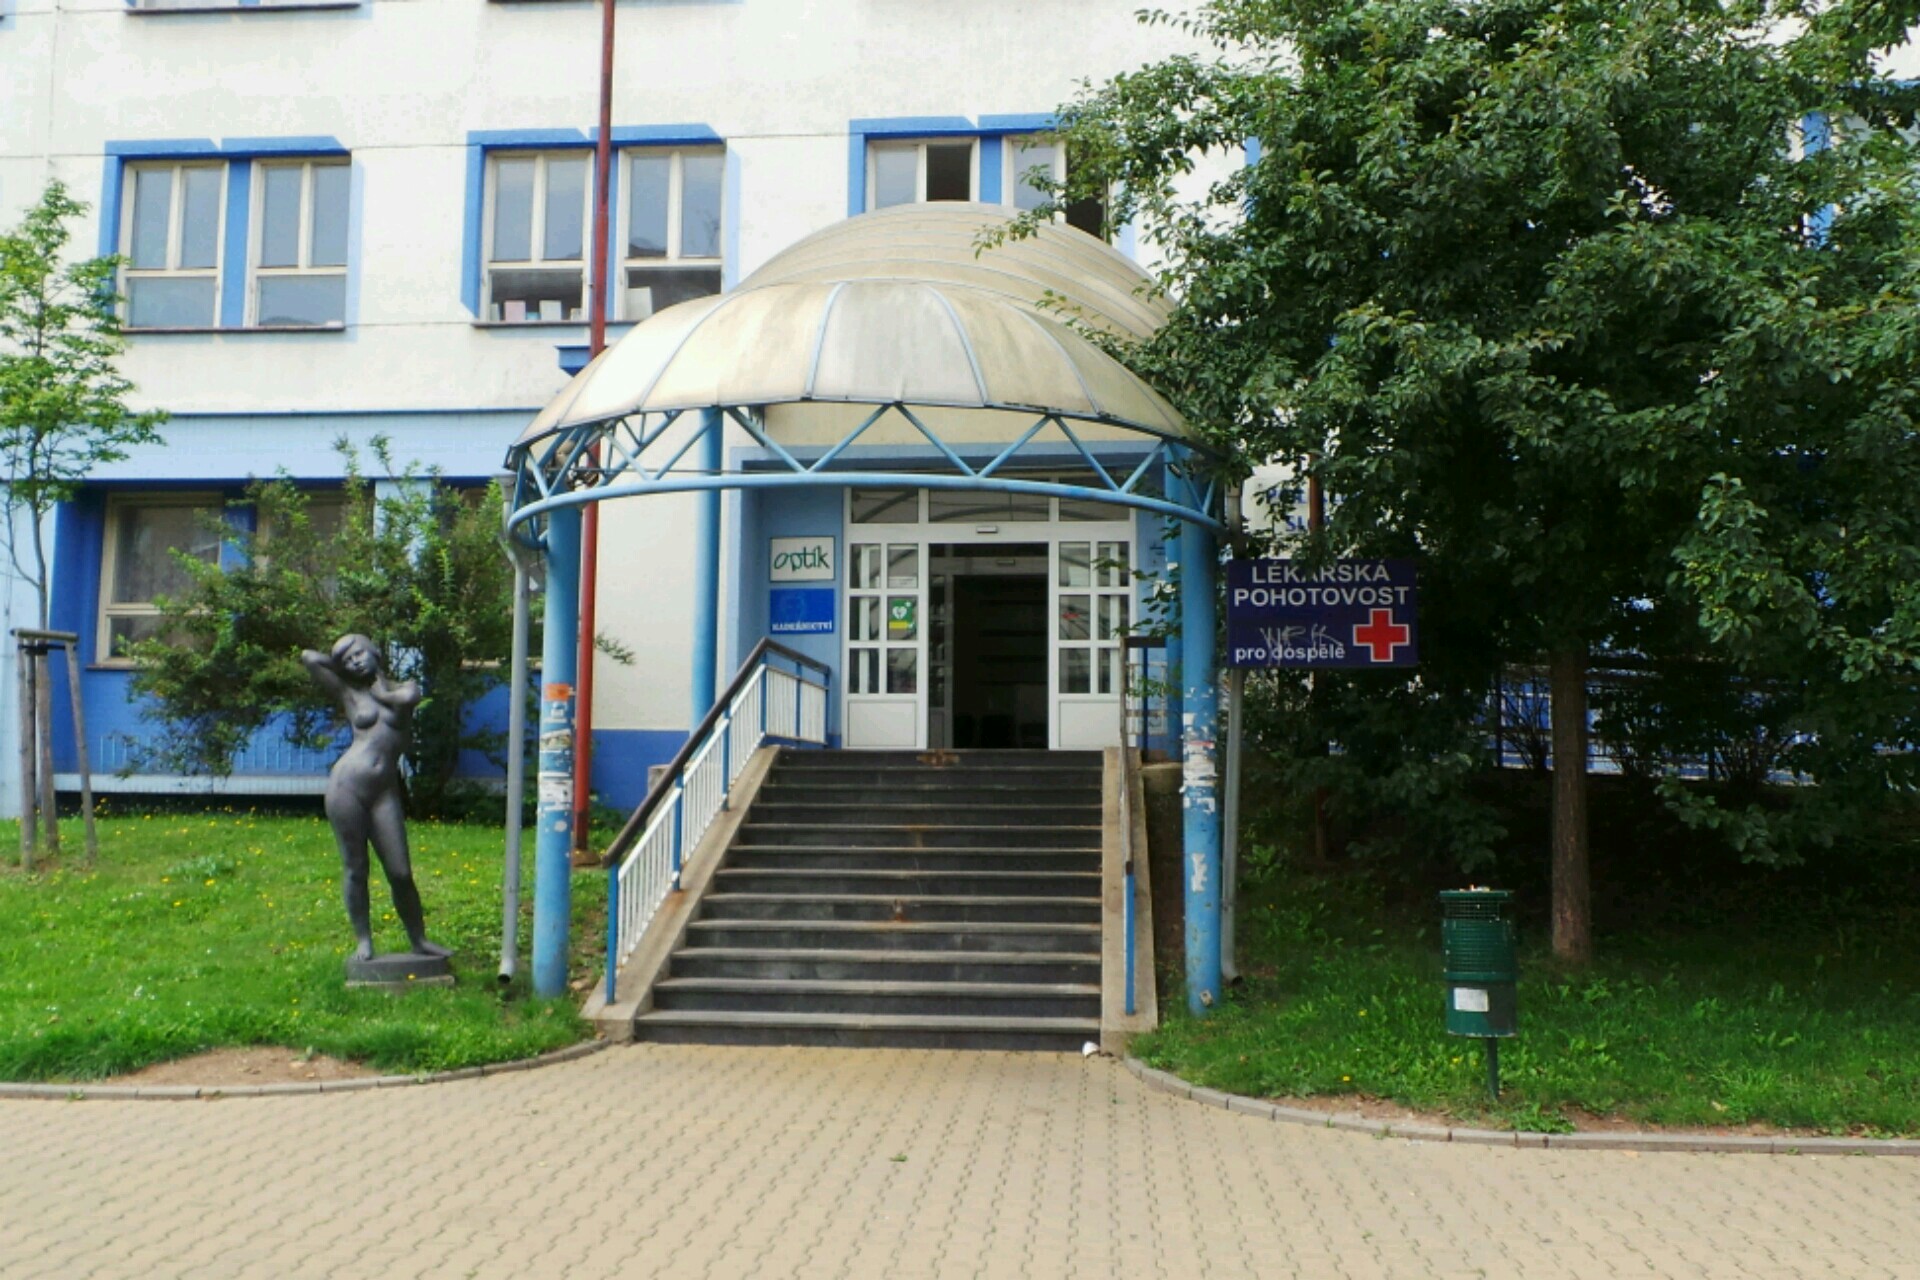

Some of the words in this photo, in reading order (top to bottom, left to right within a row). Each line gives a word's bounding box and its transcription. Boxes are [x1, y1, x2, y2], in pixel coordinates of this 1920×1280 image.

[773, 545, 830, 571] optik
[1234, 586, 1409, 607] POHOTOVOST
[1235, 646, 1267, 663] pro
